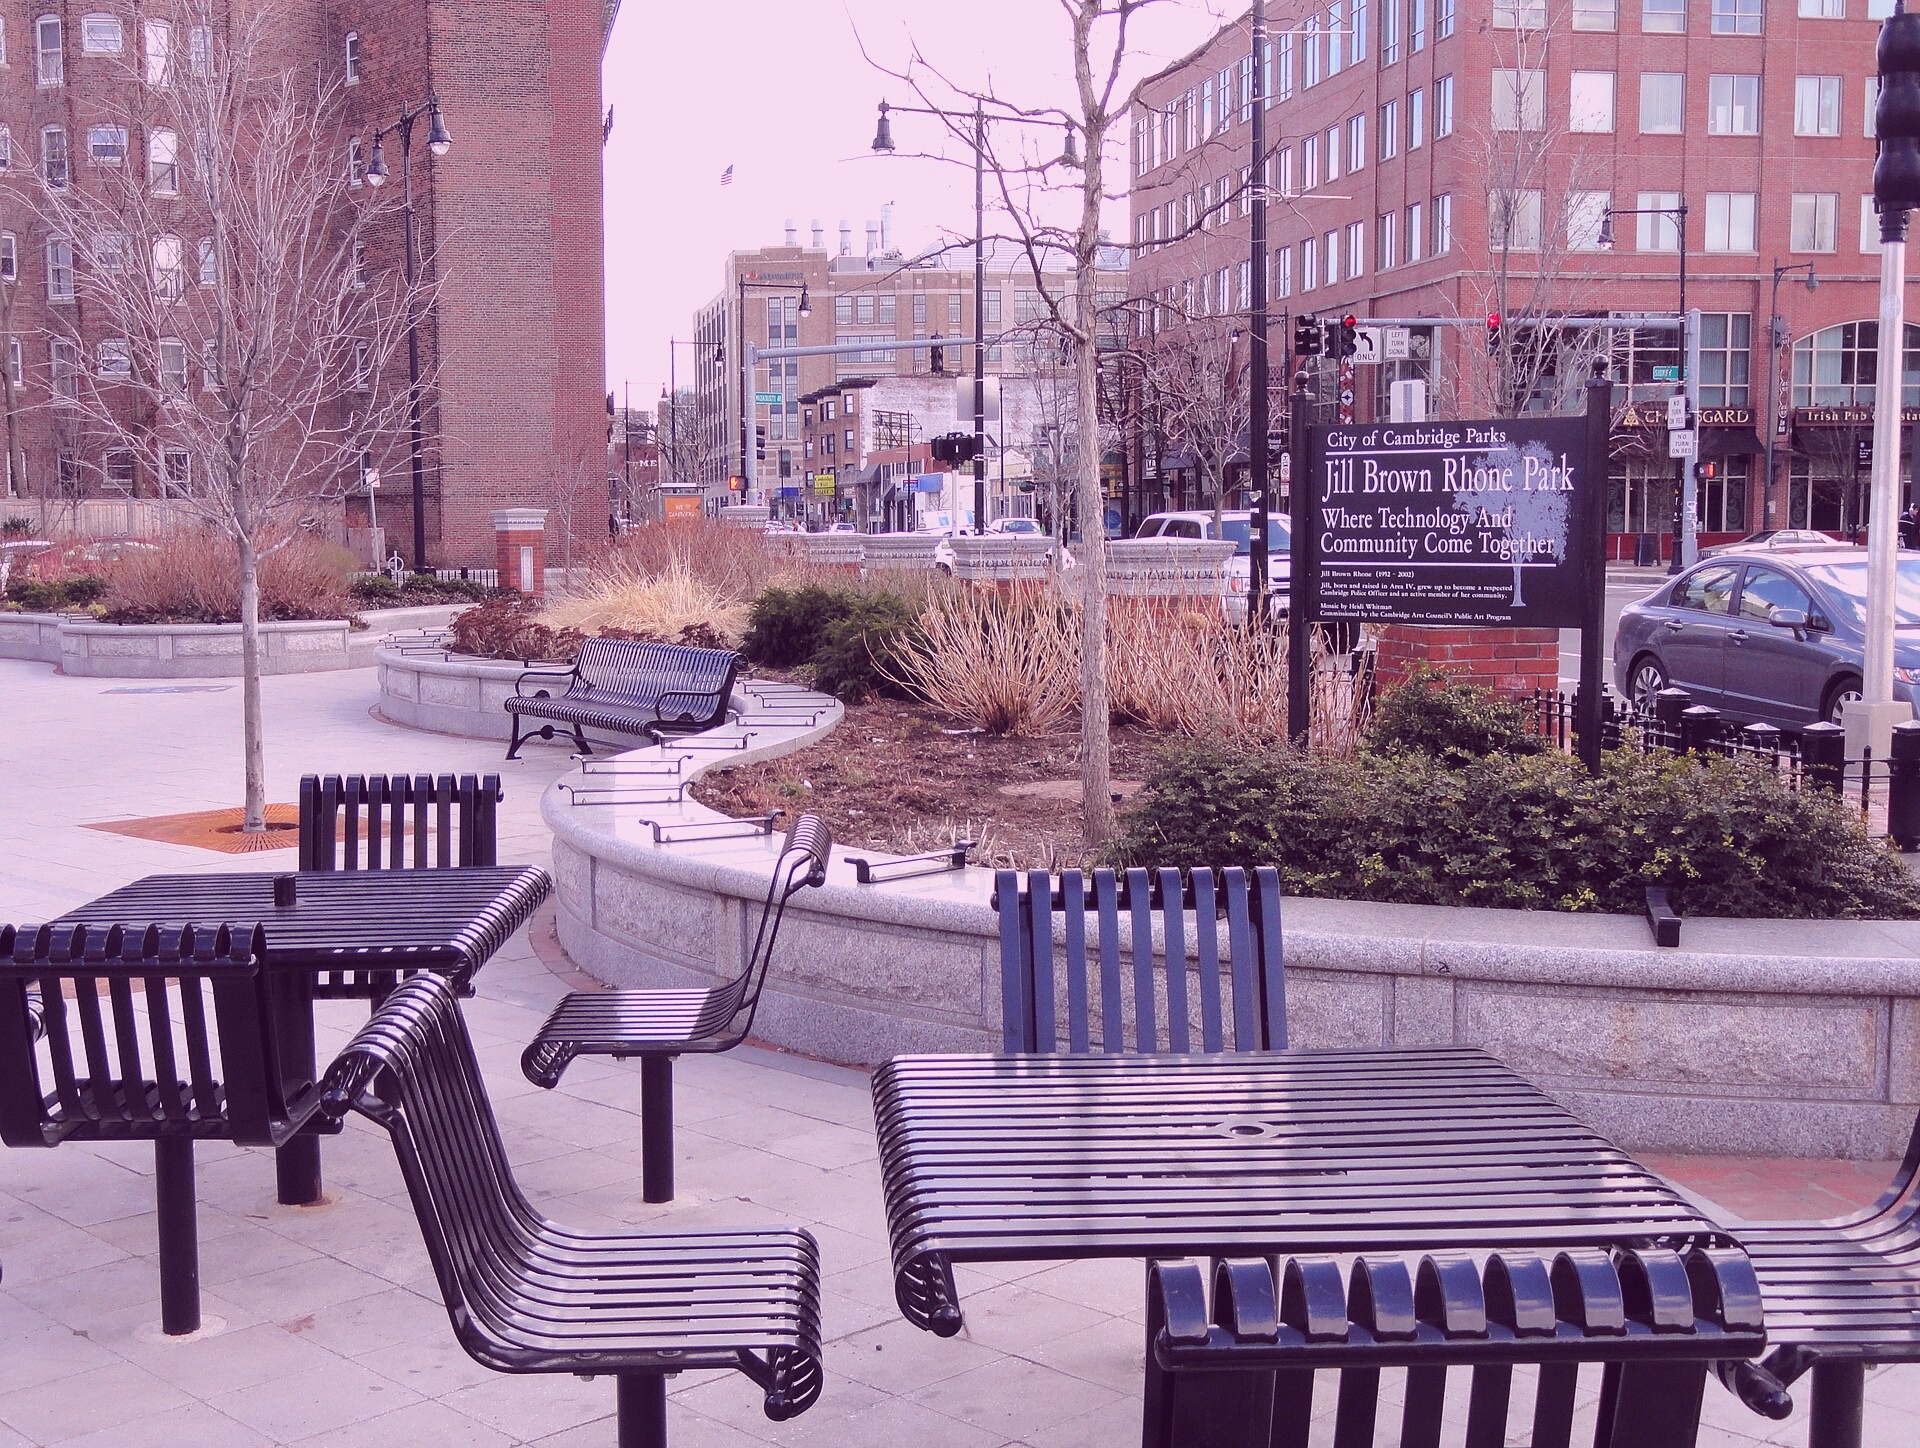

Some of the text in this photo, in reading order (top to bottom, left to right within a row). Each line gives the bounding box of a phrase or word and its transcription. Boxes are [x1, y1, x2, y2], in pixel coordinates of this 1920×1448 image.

[1356, 353, 1377, 361] ONLY
[1808, 411, 1839, 421] Irish
[1844, 411, 1867, 421] Pub
[1327, 427, 1506, 451] City of Cambridge Parks
[1321, 458, 1354, 502] Jill
[1363, 459, 1433, 493] Brown
[1441, 455, 1513, 492] Rhone
[1522, 452, 1575, 491] Park
[1321, 506, 1512, 535] Where Technology And
[1320, 531, 1555, 560] Community Come Together
[1340, 602, 1348, 610] by
[1380, 611, 1411, 619] Cambridge
